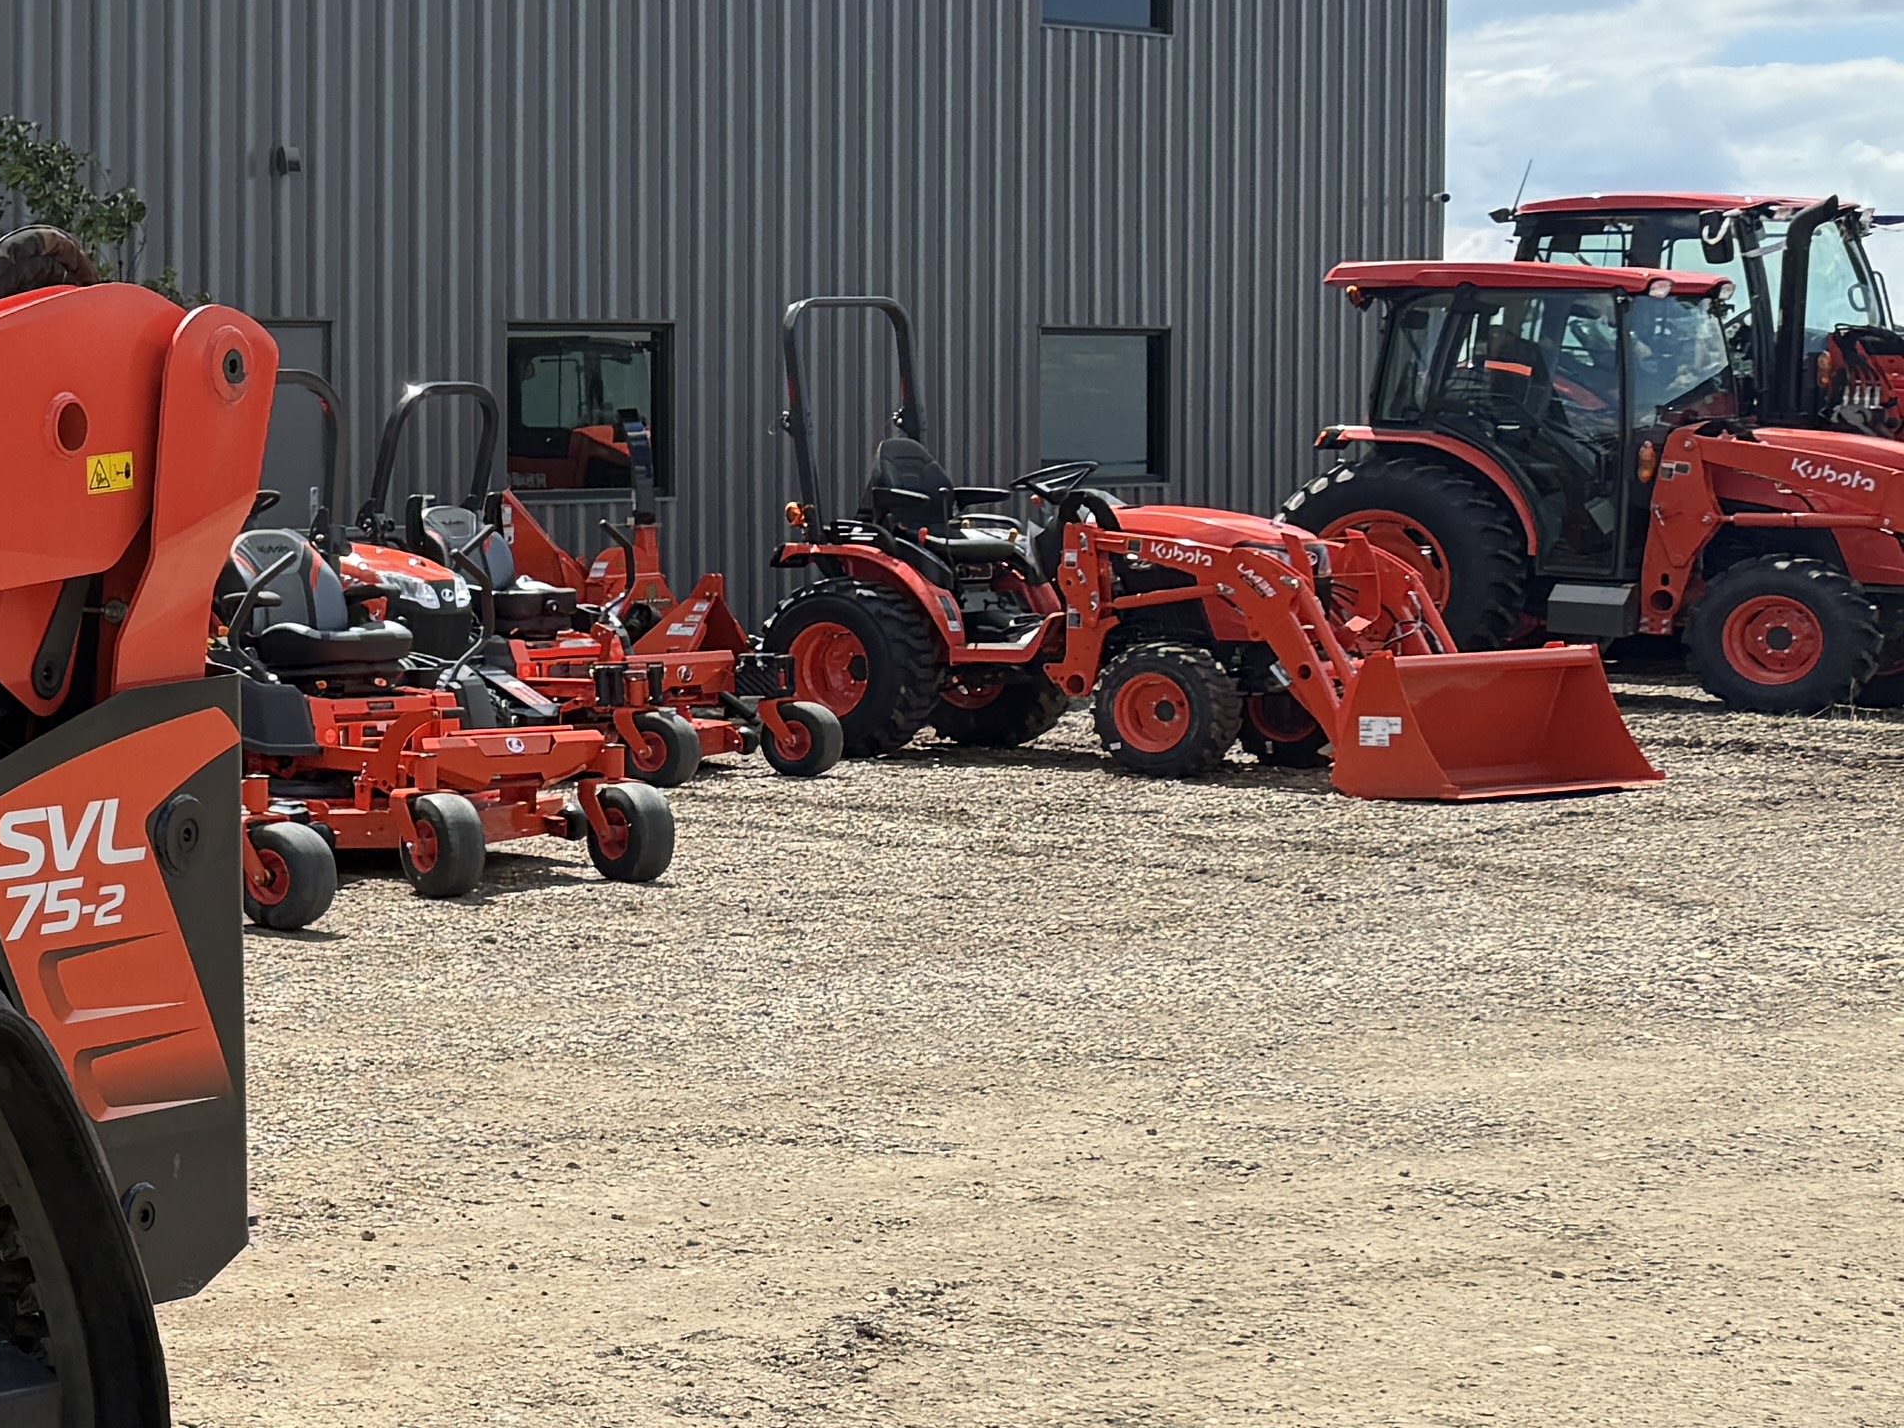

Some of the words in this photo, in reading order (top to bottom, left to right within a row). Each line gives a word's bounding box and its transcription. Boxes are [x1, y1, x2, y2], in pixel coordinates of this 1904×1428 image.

[1791, 457, 1876, 492] Kubota
[1150, 540, 1213, 567] Kubota
[5, 876, 126, 942] 75-2
